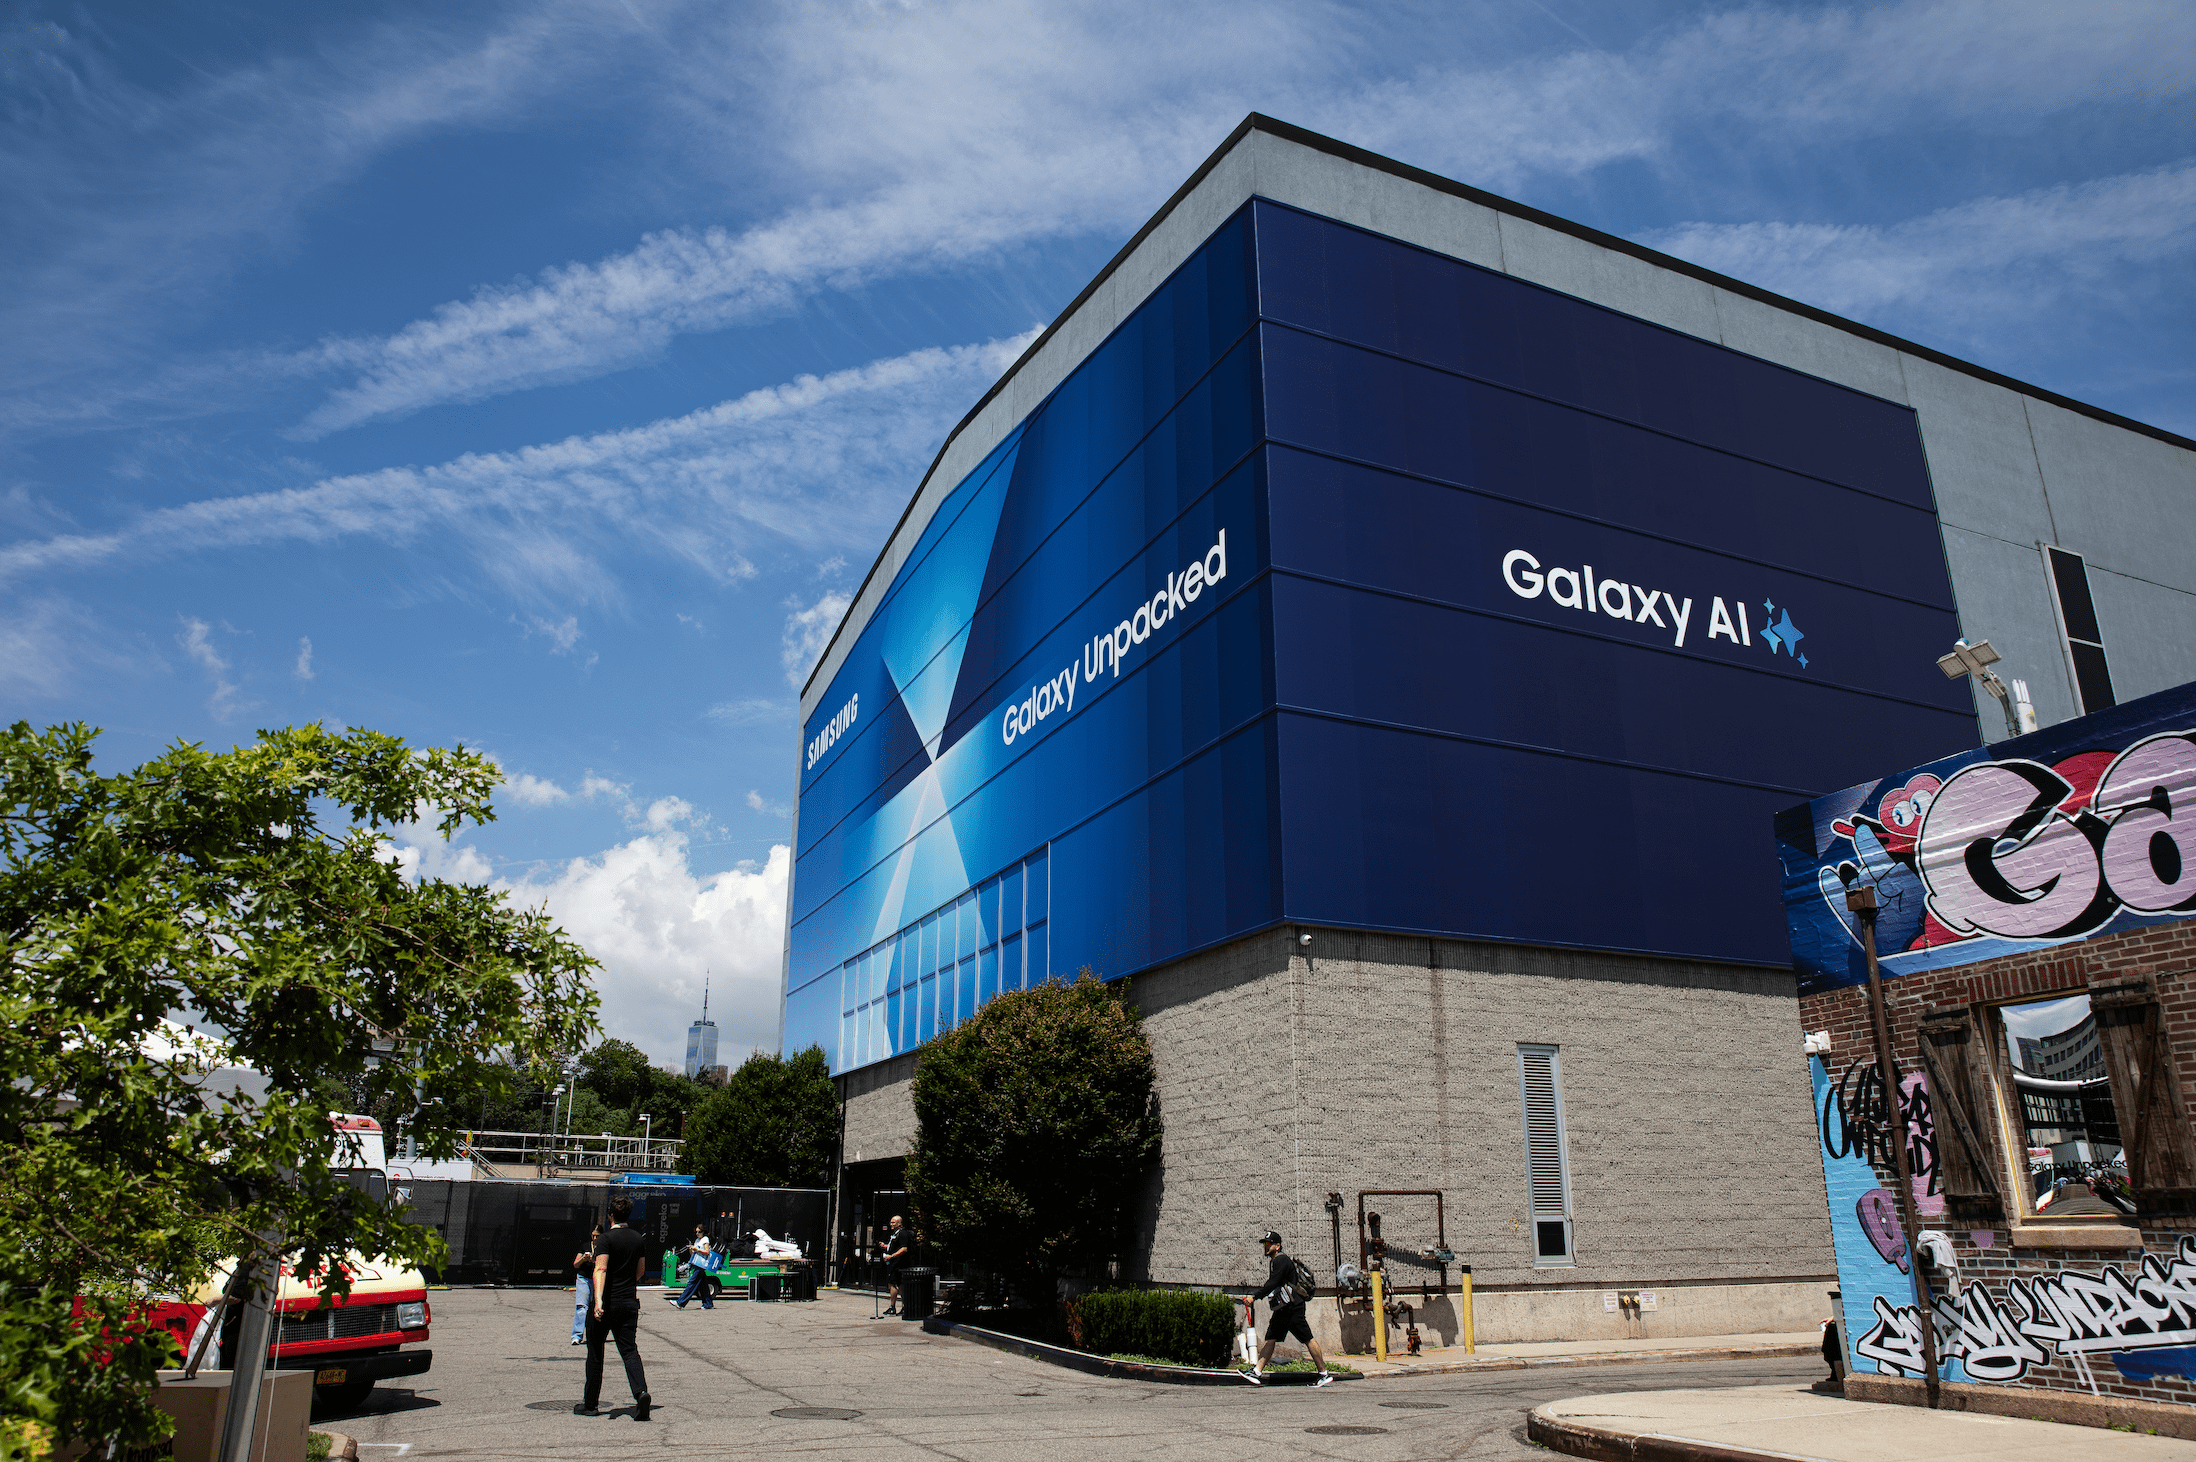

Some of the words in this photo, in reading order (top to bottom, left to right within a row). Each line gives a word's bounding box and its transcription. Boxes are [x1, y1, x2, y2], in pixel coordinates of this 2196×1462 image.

[1002, 659, 1080, 746] Galaxy
[1084, 527, 1228, 679] Unpacked
[1502, 549, 1693, 648] Galaxy
[1707, 595, 1751, 647] AI
[806, 692, 859, 771] SAMSUNG
[2026, 1160, 2065, 1172] Galaxy
[658, 1203, 669, 1243] aggreko
